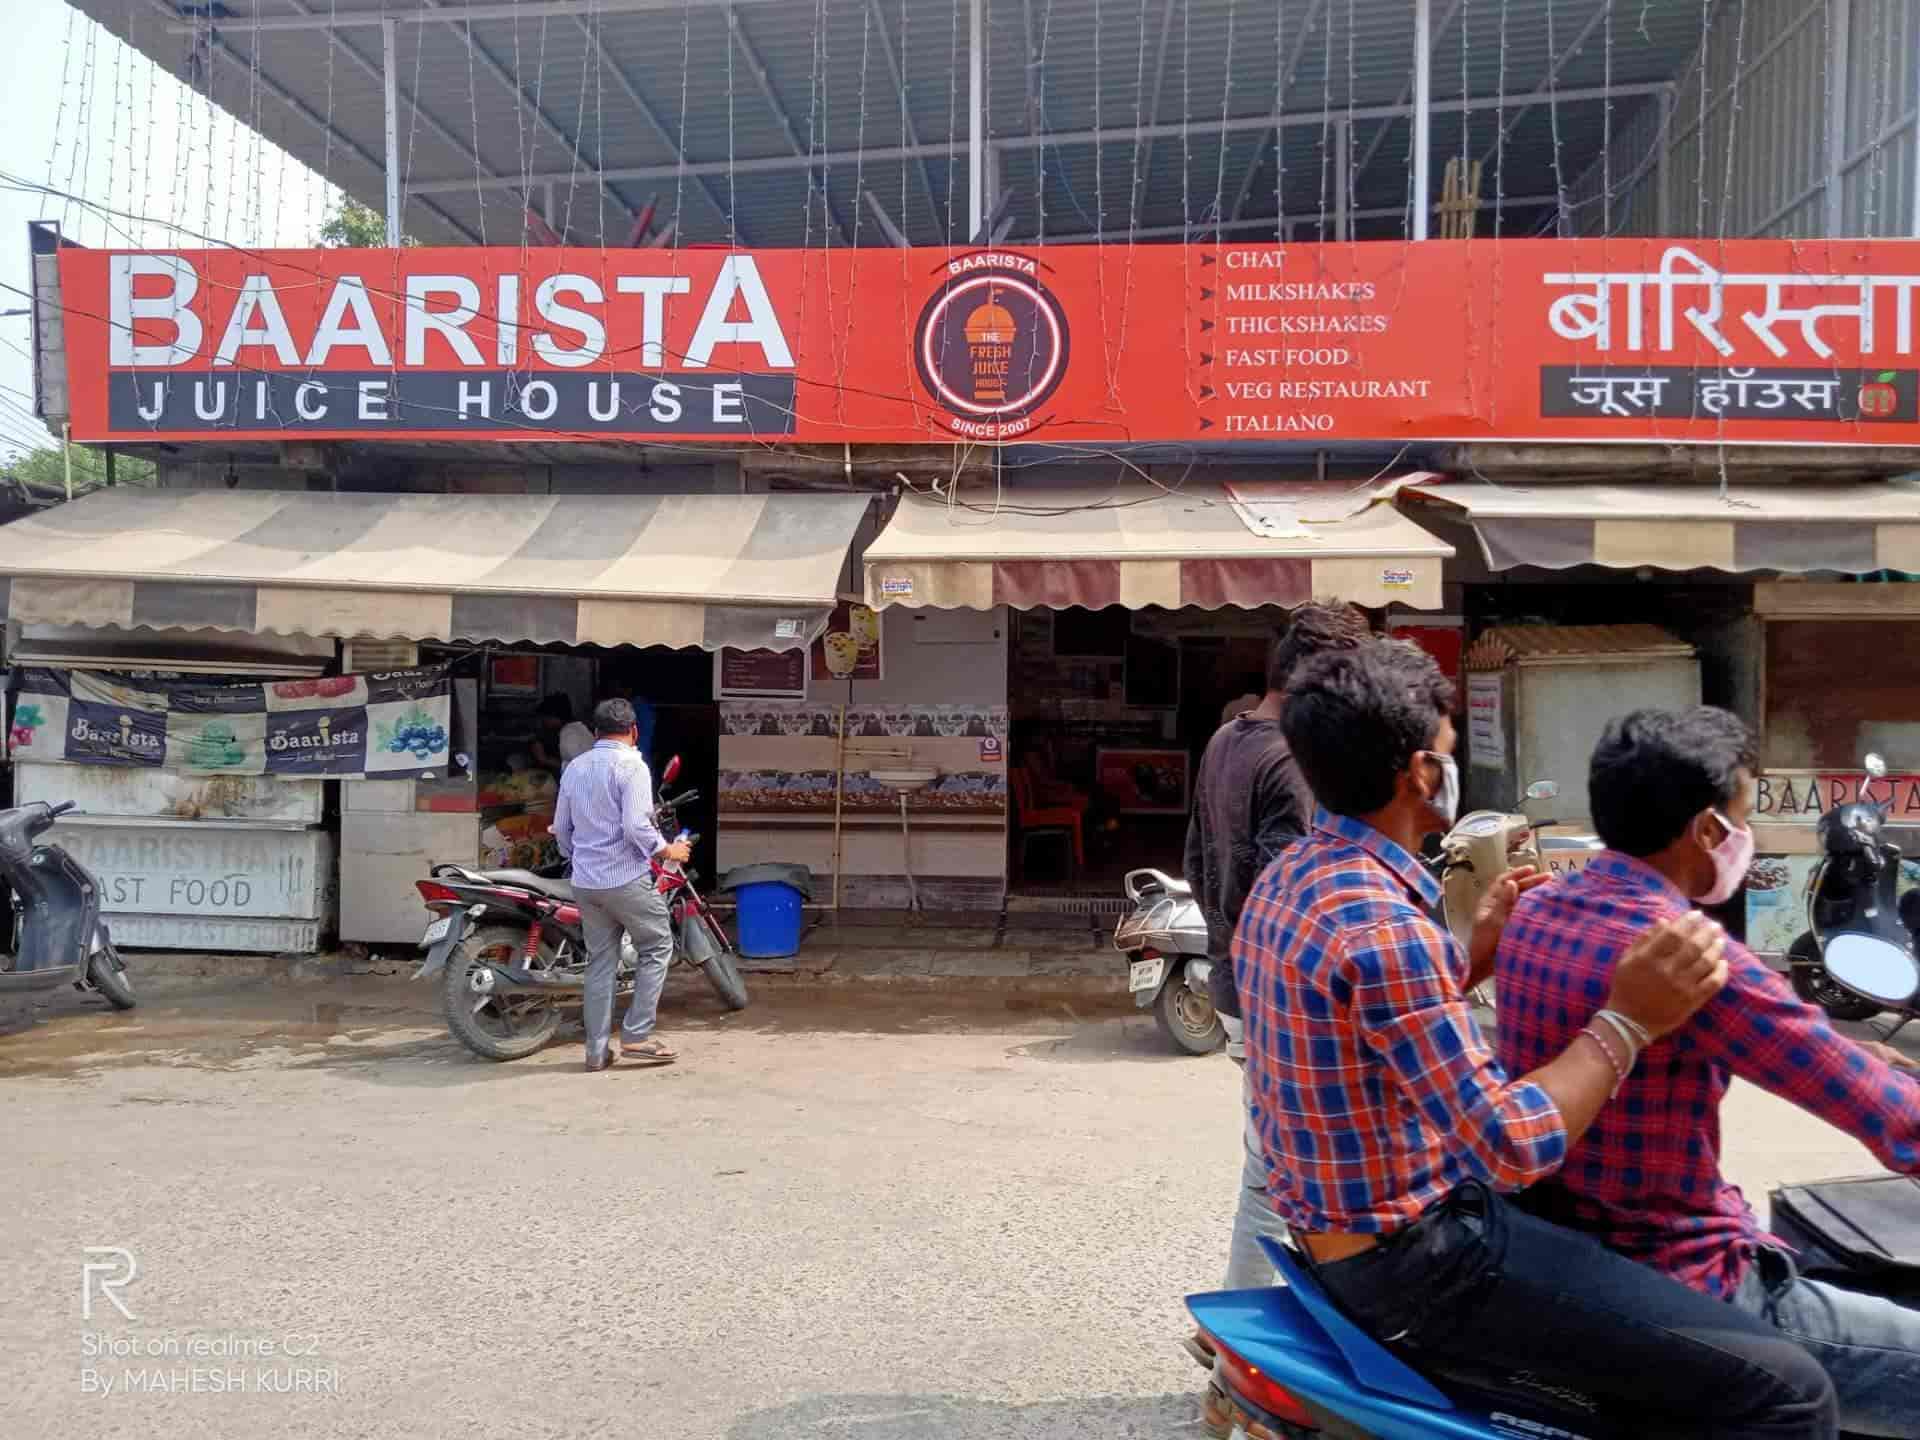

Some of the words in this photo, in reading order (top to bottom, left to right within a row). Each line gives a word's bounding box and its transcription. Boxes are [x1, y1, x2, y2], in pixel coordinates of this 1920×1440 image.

[948, 254, 1037, 275] BAARISTA
[1225, 251, 1288, 268] CHAT
[1225, 282, 1376, 301] MILKSHAKES
[108, 254, 796, 368] BAARISTA
[1543, 246, 1920, 358] बारिस्ता
[1225, 315, 1388, 334] THICKSHAKES
[970, 345, 1012, 358] FRESH
[1225, 349, 1280, 367] FAST
[1285, 348, 1350, 366] FOOD
[972, 361, 1009, 375] JUICE
[1224, 381, 1272, 399] VEG
[1279, 380, 1432, 400] RESTAURANT
[1569, 376, 1670, 416] जूस
[1700, 367, 1841, 413] हॉउस
[138, 381, 389, 423] JUICE
[457, 381, 744, 424] HOUSE
[951, 417, 995, 437] SINCE
[1000, 417, 1032, 436] 2007
[1224, 414, 1335, 432] ITALIANO
[98, 876, 146, 904] AST
[169, 878, 252, 907] FOOD
